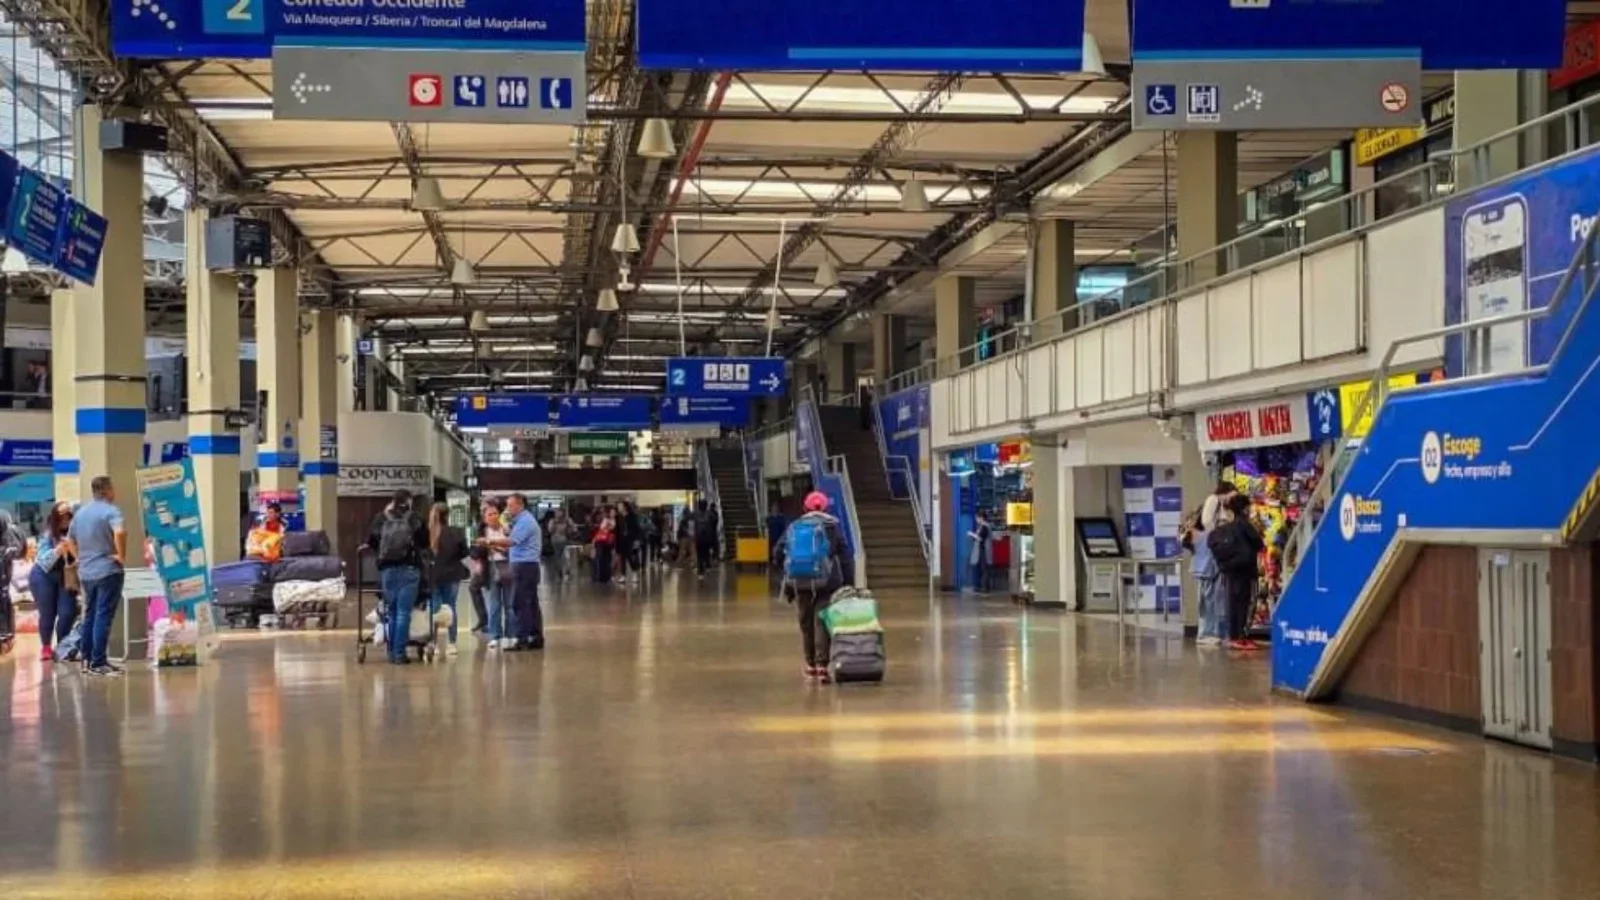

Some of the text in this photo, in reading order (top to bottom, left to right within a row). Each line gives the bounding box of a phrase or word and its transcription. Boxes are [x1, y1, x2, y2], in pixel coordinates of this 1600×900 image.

[304, 13, 362, 26] Mosquera
[372, 14, 411, 26] Siberia
[421, 15, 461, 27] Troncal
[464, 16, 481, 28] del
[484, 17, 548, 31] Magdalena
[672, 368, 686, 385] 2
[1424, 432, 1482, 468] 02 Escoge
[1343, 494, 1383, 529] 01 Busca
